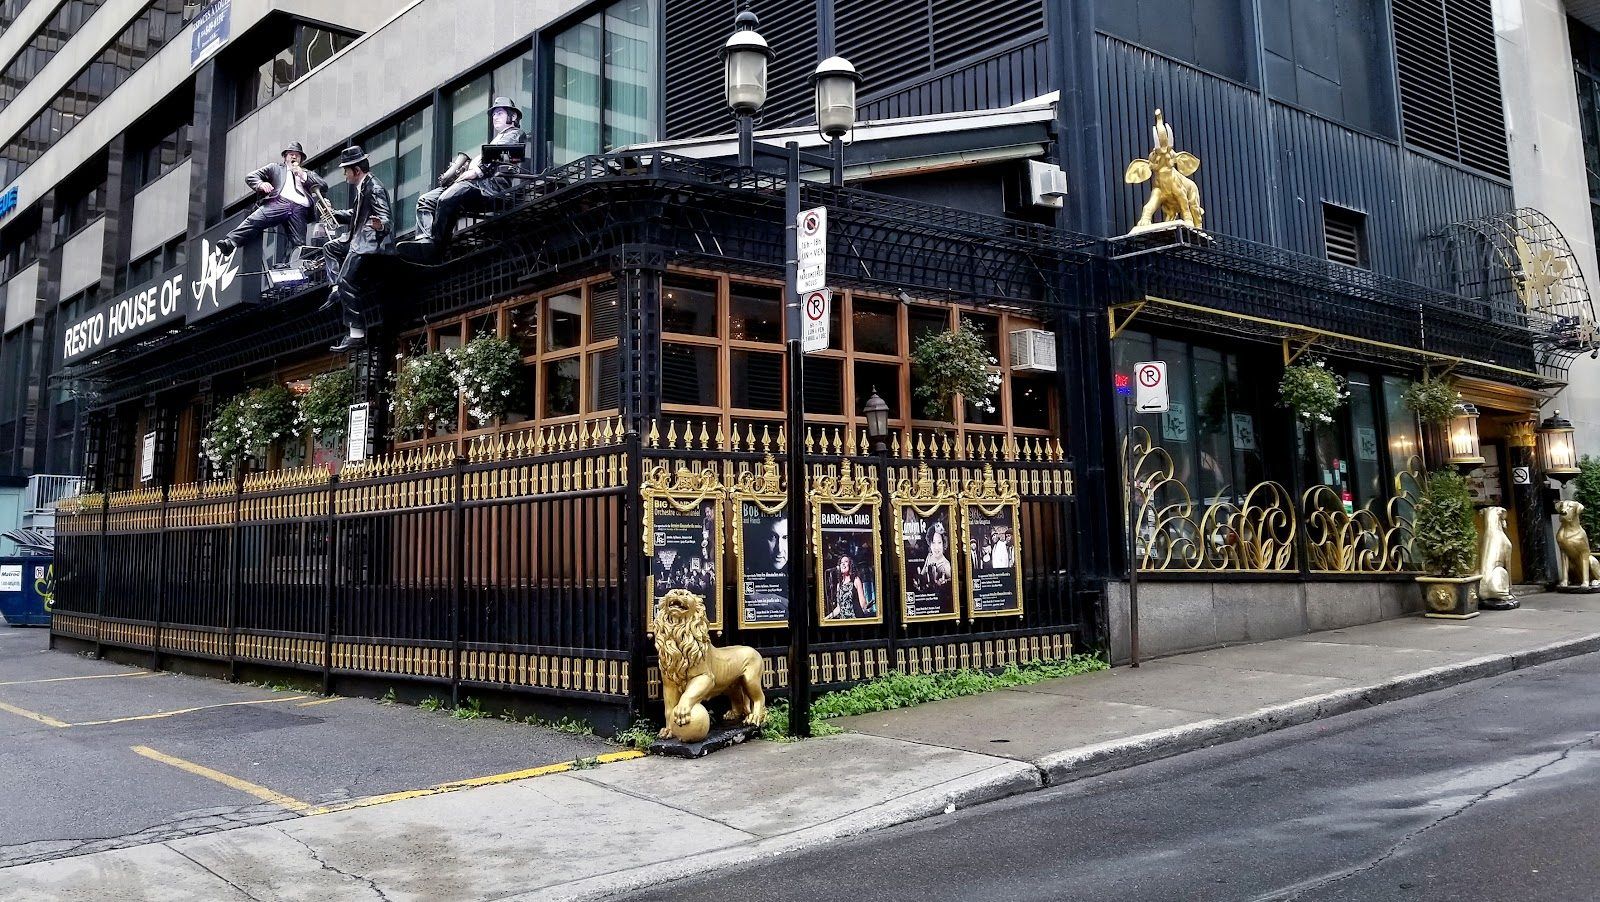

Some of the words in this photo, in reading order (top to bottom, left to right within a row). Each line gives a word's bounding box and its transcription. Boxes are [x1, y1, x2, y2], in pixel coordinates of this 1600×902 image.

[63, 312, 104, 359] RESTO
[108, 286, 157, 338] HOUSE
[160, 273, 183, 316] OF
[654, 500, 668, 509] BIG
[743, 503, 759, 517] BOB
[821, 513, 853, 525] BARBARA
[854, 514, 870, 525] DIAB
